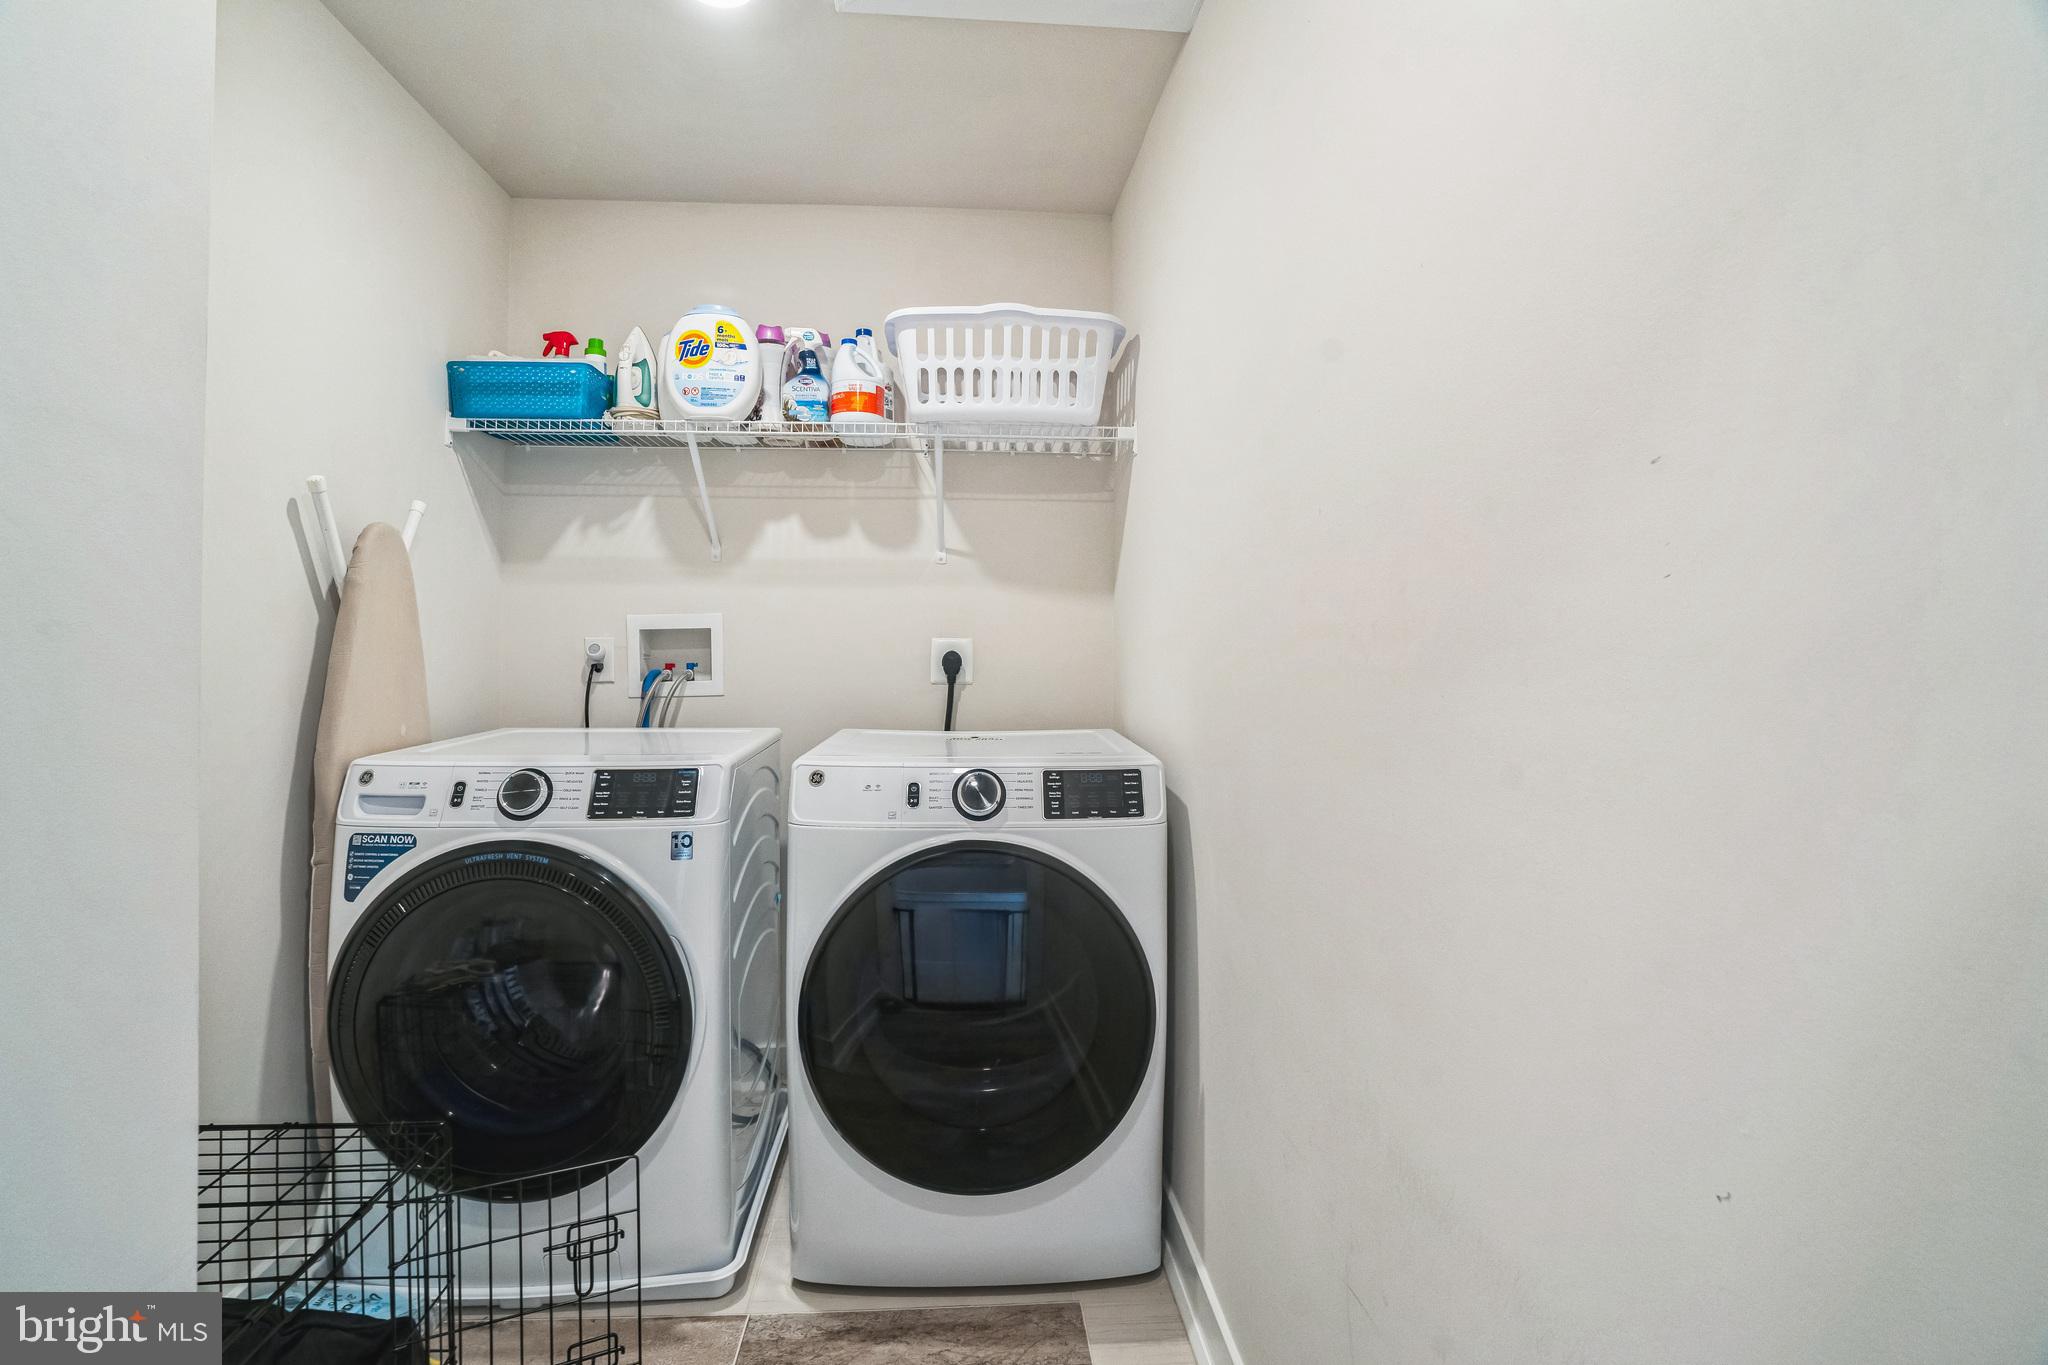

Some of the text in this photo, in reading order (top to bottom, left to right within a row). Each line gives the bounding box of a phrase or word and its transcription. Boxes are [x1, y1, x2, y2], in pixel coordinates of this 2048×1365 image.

[678, 339, 711, 362] Tide
[362, 835, 414, 844] SCAN NOW
[464, 852, 550, 865] ULTRAFRESH VENT SYSTEM
